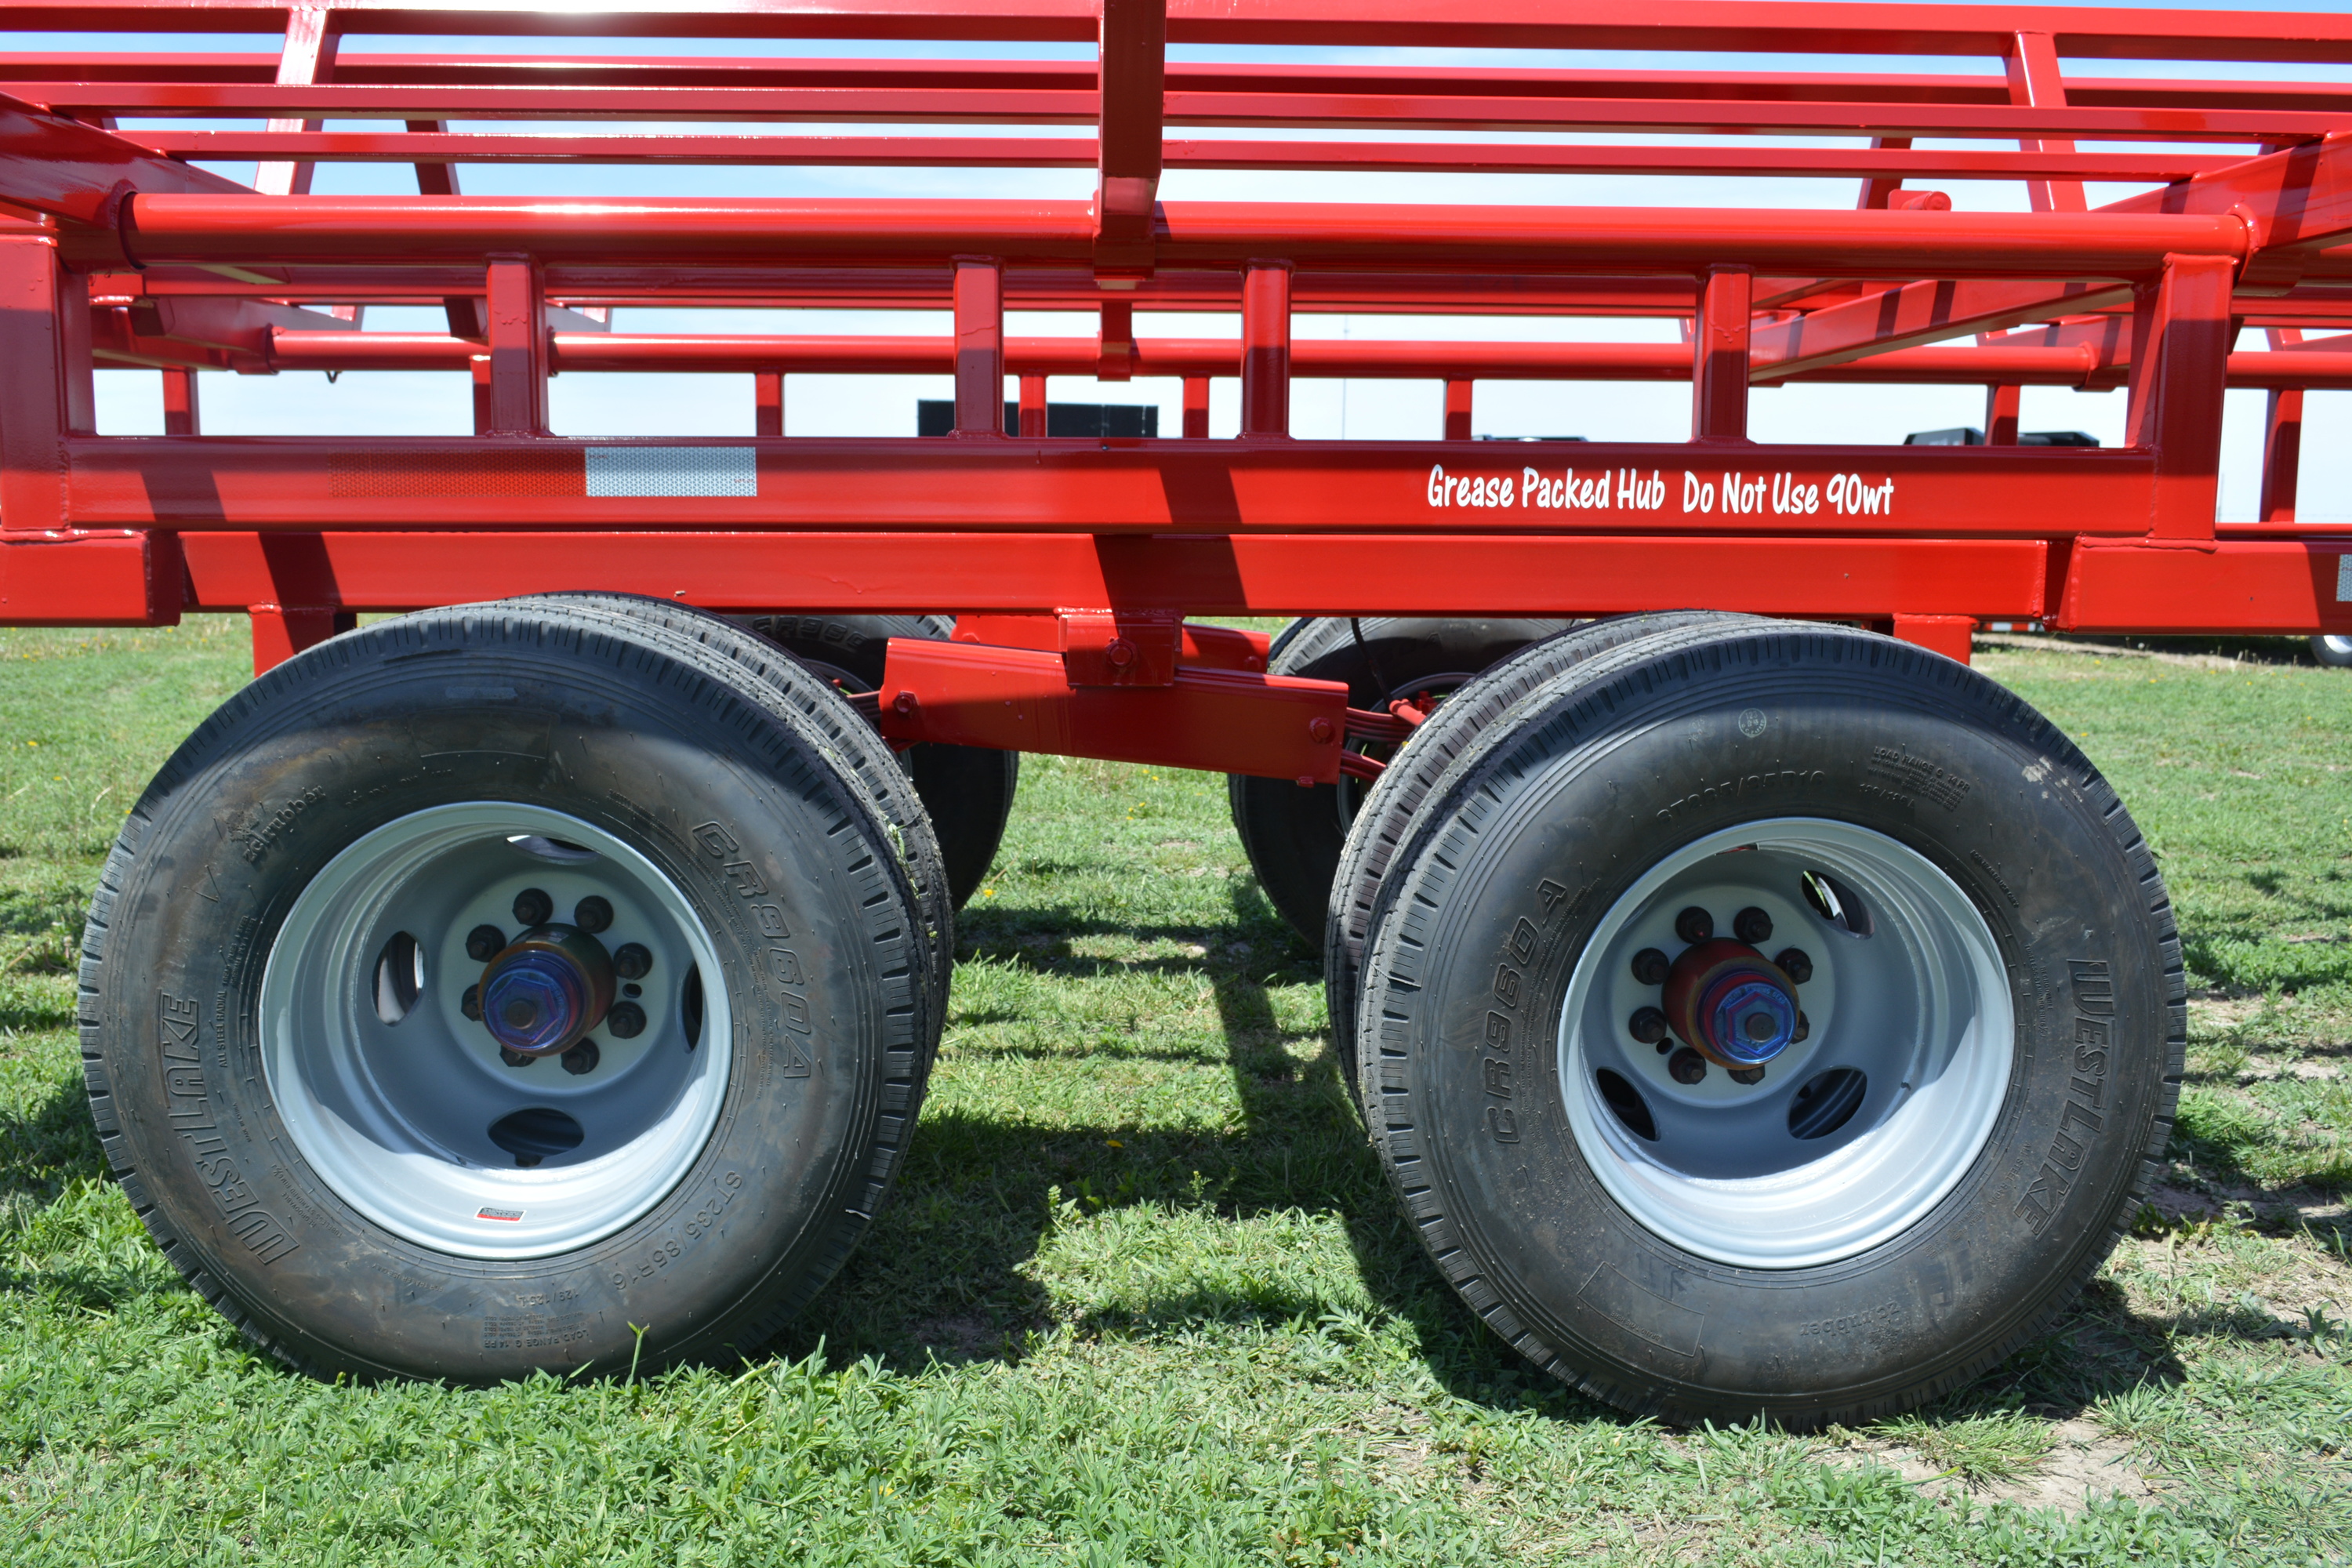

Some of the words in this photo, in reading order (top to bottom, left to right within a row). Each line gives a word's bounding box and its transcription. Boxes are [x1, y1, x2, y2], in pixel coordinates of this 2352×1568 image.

[1428, 464, 1514, 507] Grease
[1523, 467, 1610, 510] Packed
[1617, 468, 1665, 510] Hub
[1683, 470, 1714, 514] Do
[1723, 473, 1766, 515] Not
[1772, 473, 1819, 515] Use
[1826, 474, 1893, 516] 90wt
[1872, 745, 1900, 762] LOAD
[1900, 751, 1935, 775] RANGE
[1944, 772, 1959, 786] 14
[256, 779, 327, 842] rubber
[689, 818, 811, 1080] CR960A
[215, 989, 227, 1022] RADIAL
[1482, 875, 1569, 1142] CR960A
[215, 1022, 226, 1050] STEEL
[216, 1052, 228, 1069] ALL
[2010, 959, 2116, 1243] WESTLAKE
[154, 988, 300, 1265] WESTLAKE
[2004, 1156, 2025, 1184] STEEL
[279, 1190, 318, 1229] REGROOVABLE
[287, 1186, 317, 1216] STANDARD
[1984, 1181, 2009, 1211] RADIAL
[313, 1212, 344, 1239] TUBELESS
[607, 1168, 746, 1293] ST235/85R16
[561, 1327, 590, 1342] LOAD
[1798, 1308, 1875, 1341] rubber
[484, 1339, 497, 1348] PR
[499, 1339, 509, 1348] 14
[514, 1339, 522, 1348] G
[525, 1334, 560, 1348] RANGE
